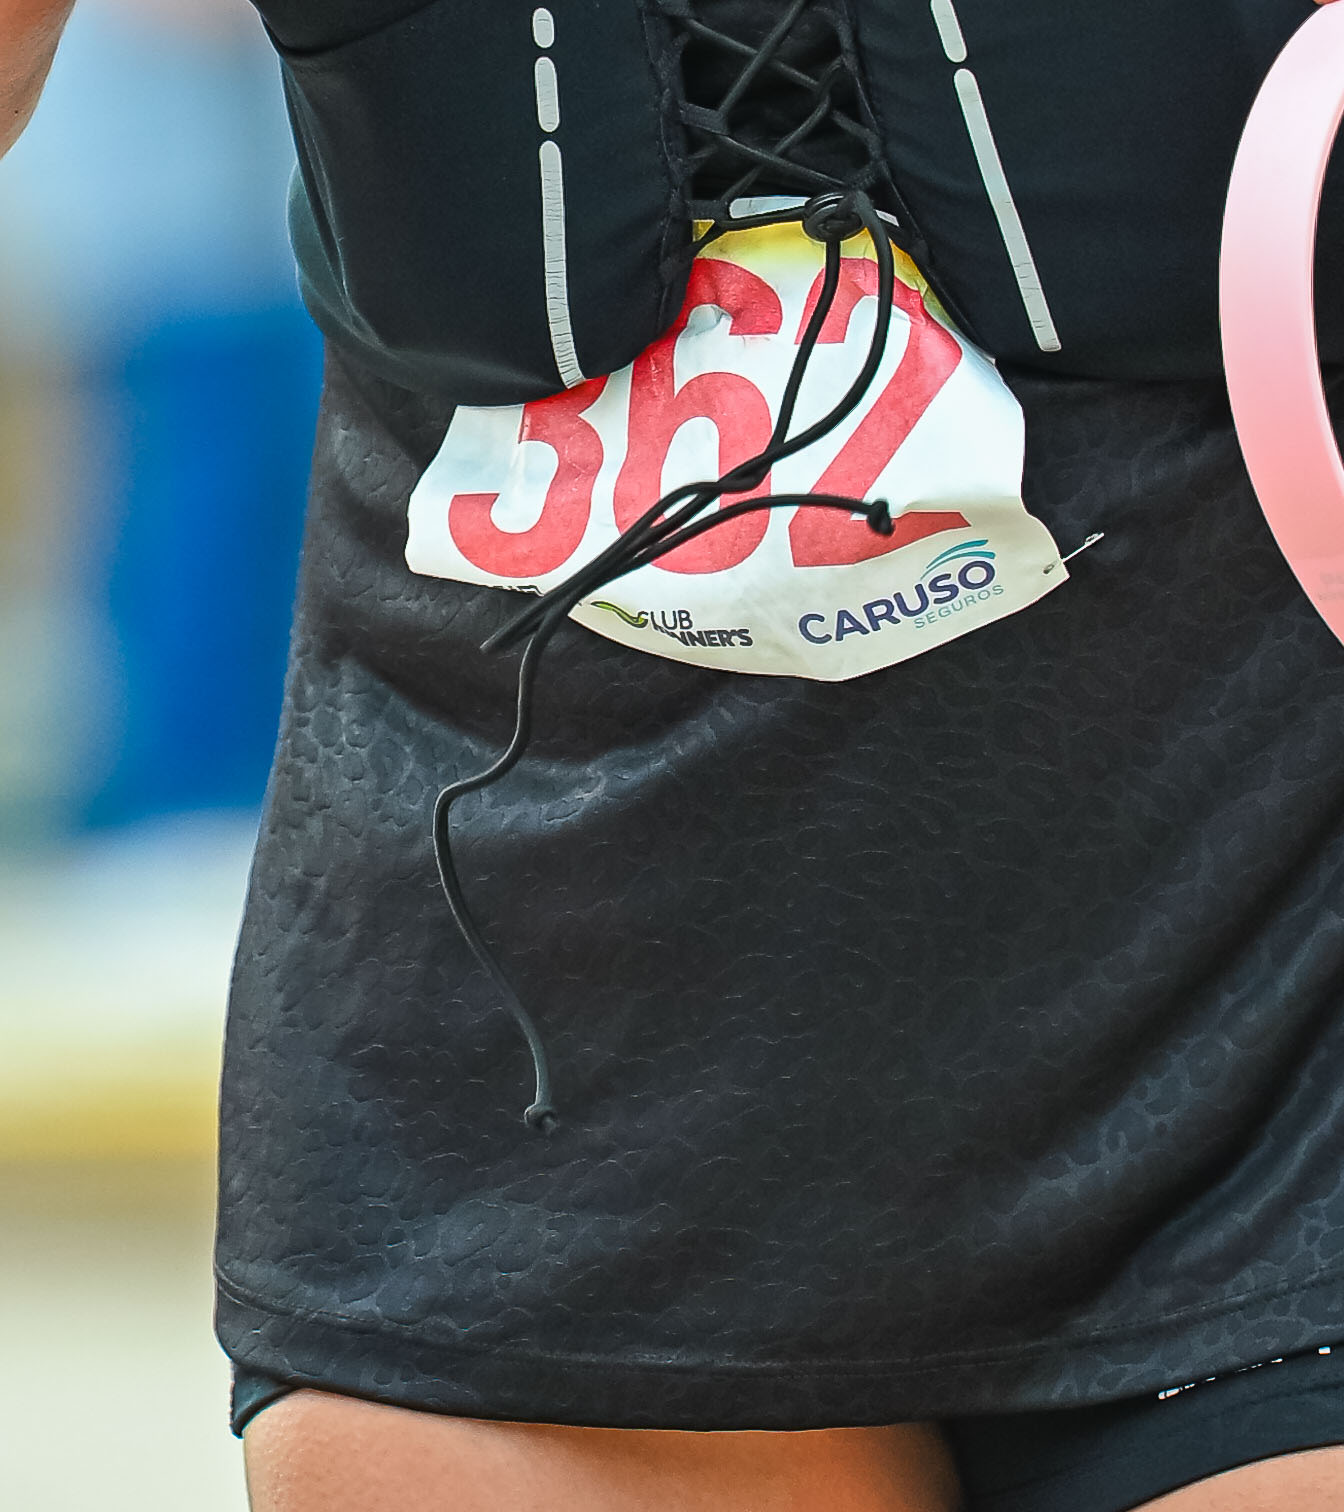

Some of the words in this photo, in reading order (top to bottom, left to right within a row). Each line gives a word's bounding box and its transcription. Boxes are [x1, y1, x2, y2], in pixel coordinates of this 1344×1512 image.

[448, 257, 972, 576] 362
[798, 560, 996, 644] CARUSO
[913, 584, 1004, 629] SEGUROS
